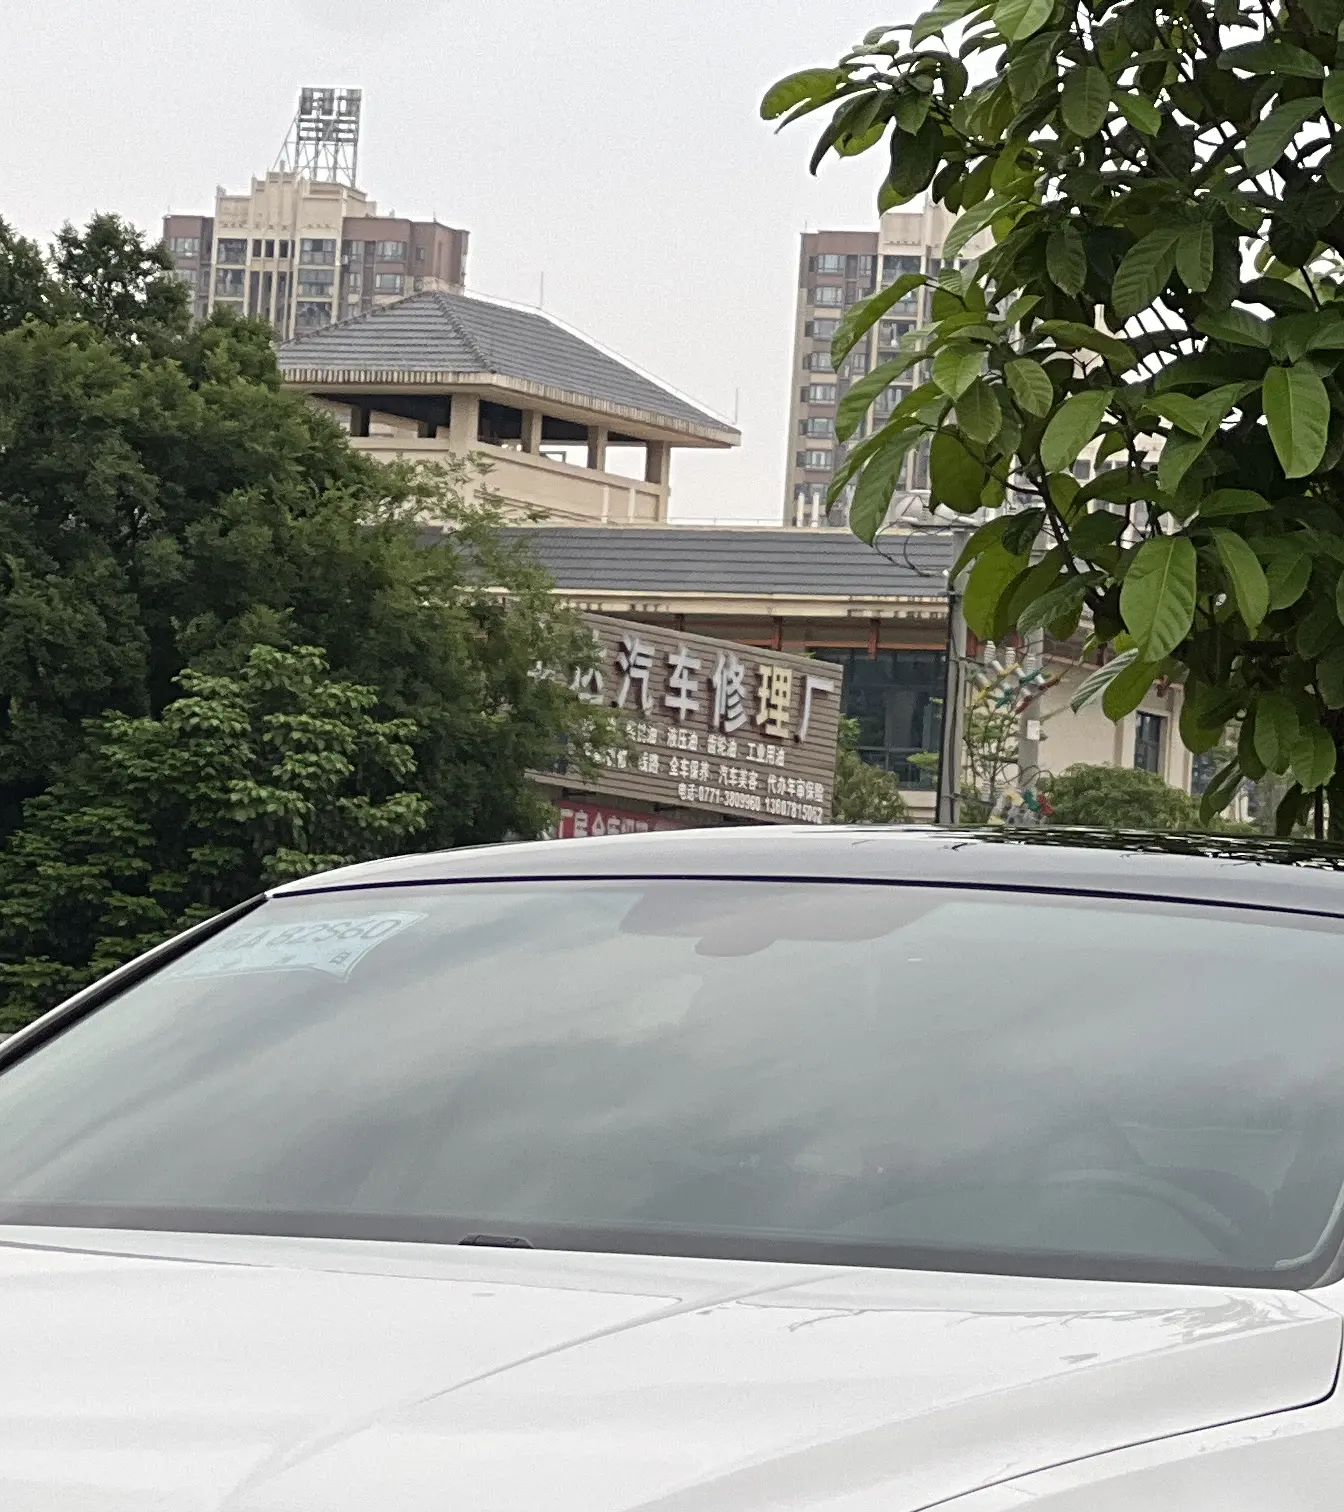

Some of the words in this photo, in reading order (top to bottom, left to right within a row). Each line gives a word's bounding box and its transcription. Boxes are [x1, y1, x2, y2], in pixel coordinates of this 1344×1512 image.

[569, 632, 836, 744] 汽车修理厂
